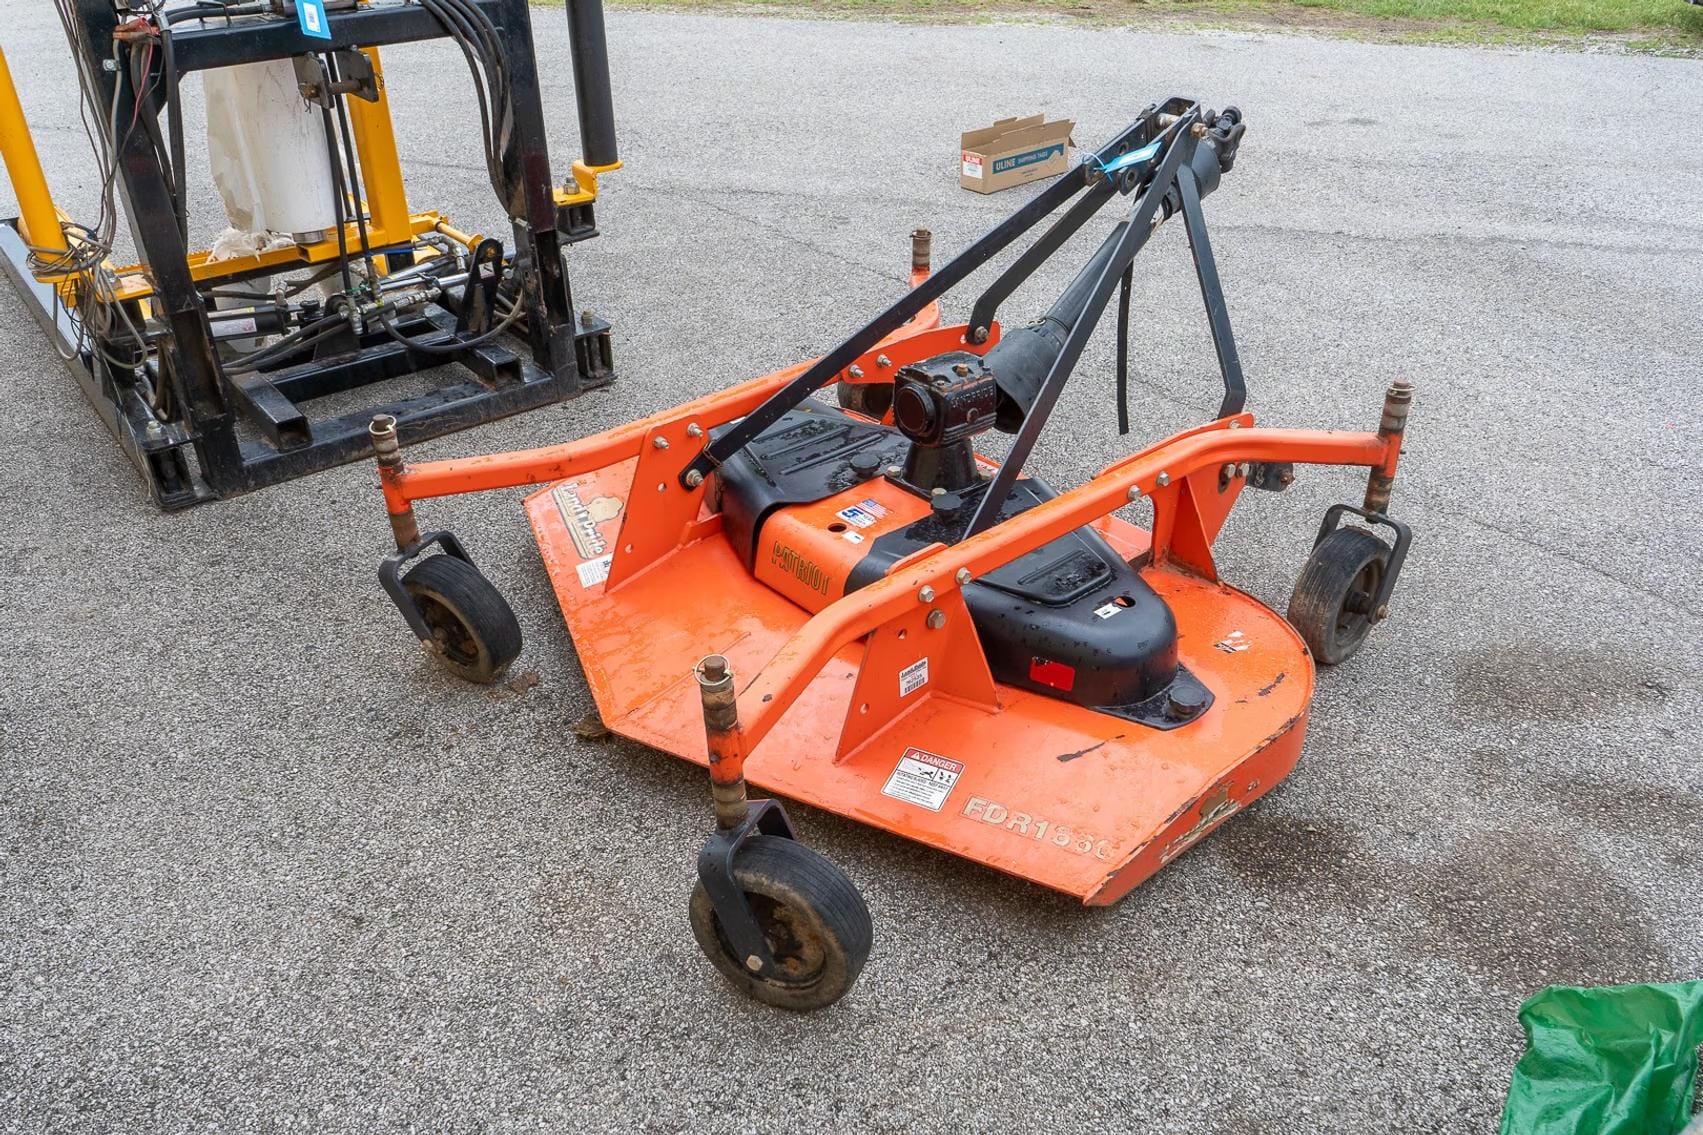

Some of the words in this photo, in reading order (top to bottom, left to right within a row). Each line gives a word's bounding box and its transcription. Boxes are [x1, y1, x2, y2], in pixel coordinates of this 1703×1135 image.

[996, 157, 1015, 170] ULINE
[841, 507, 864, 518] 5
[921, 753, 957, 770] DANGER
